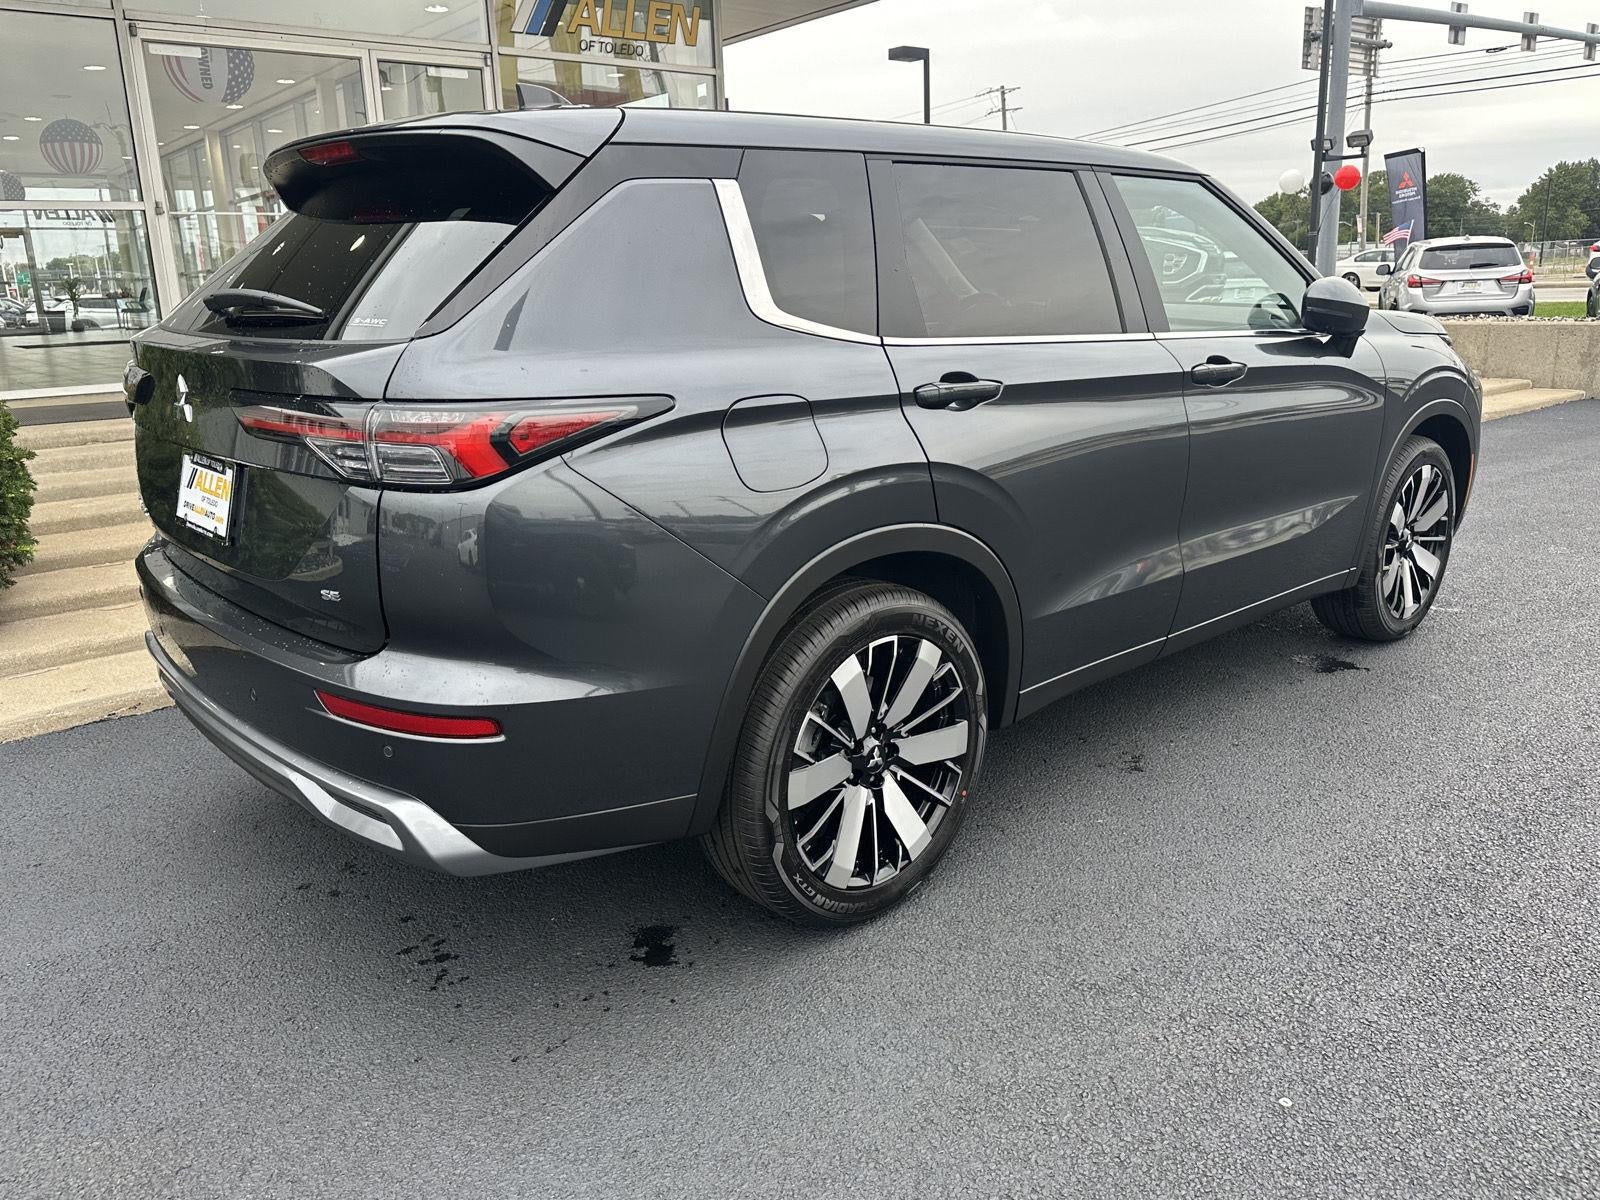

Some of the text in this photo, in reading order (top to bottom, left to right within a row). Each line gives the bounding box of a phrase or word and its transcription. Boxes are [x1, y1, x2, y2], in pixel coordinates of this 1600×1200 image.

[567, 0, 700, 46] ALLEN
[579, 39, 644, 57] OF TOLEDO
[198, 47, 213, 90] OWNED
[194, 470, 232, 502] ALLEN
[320, 589, 341, 601] SE
[912, 613, 965, 653] NEXEN
[793, 873, 816, 897] GTX
